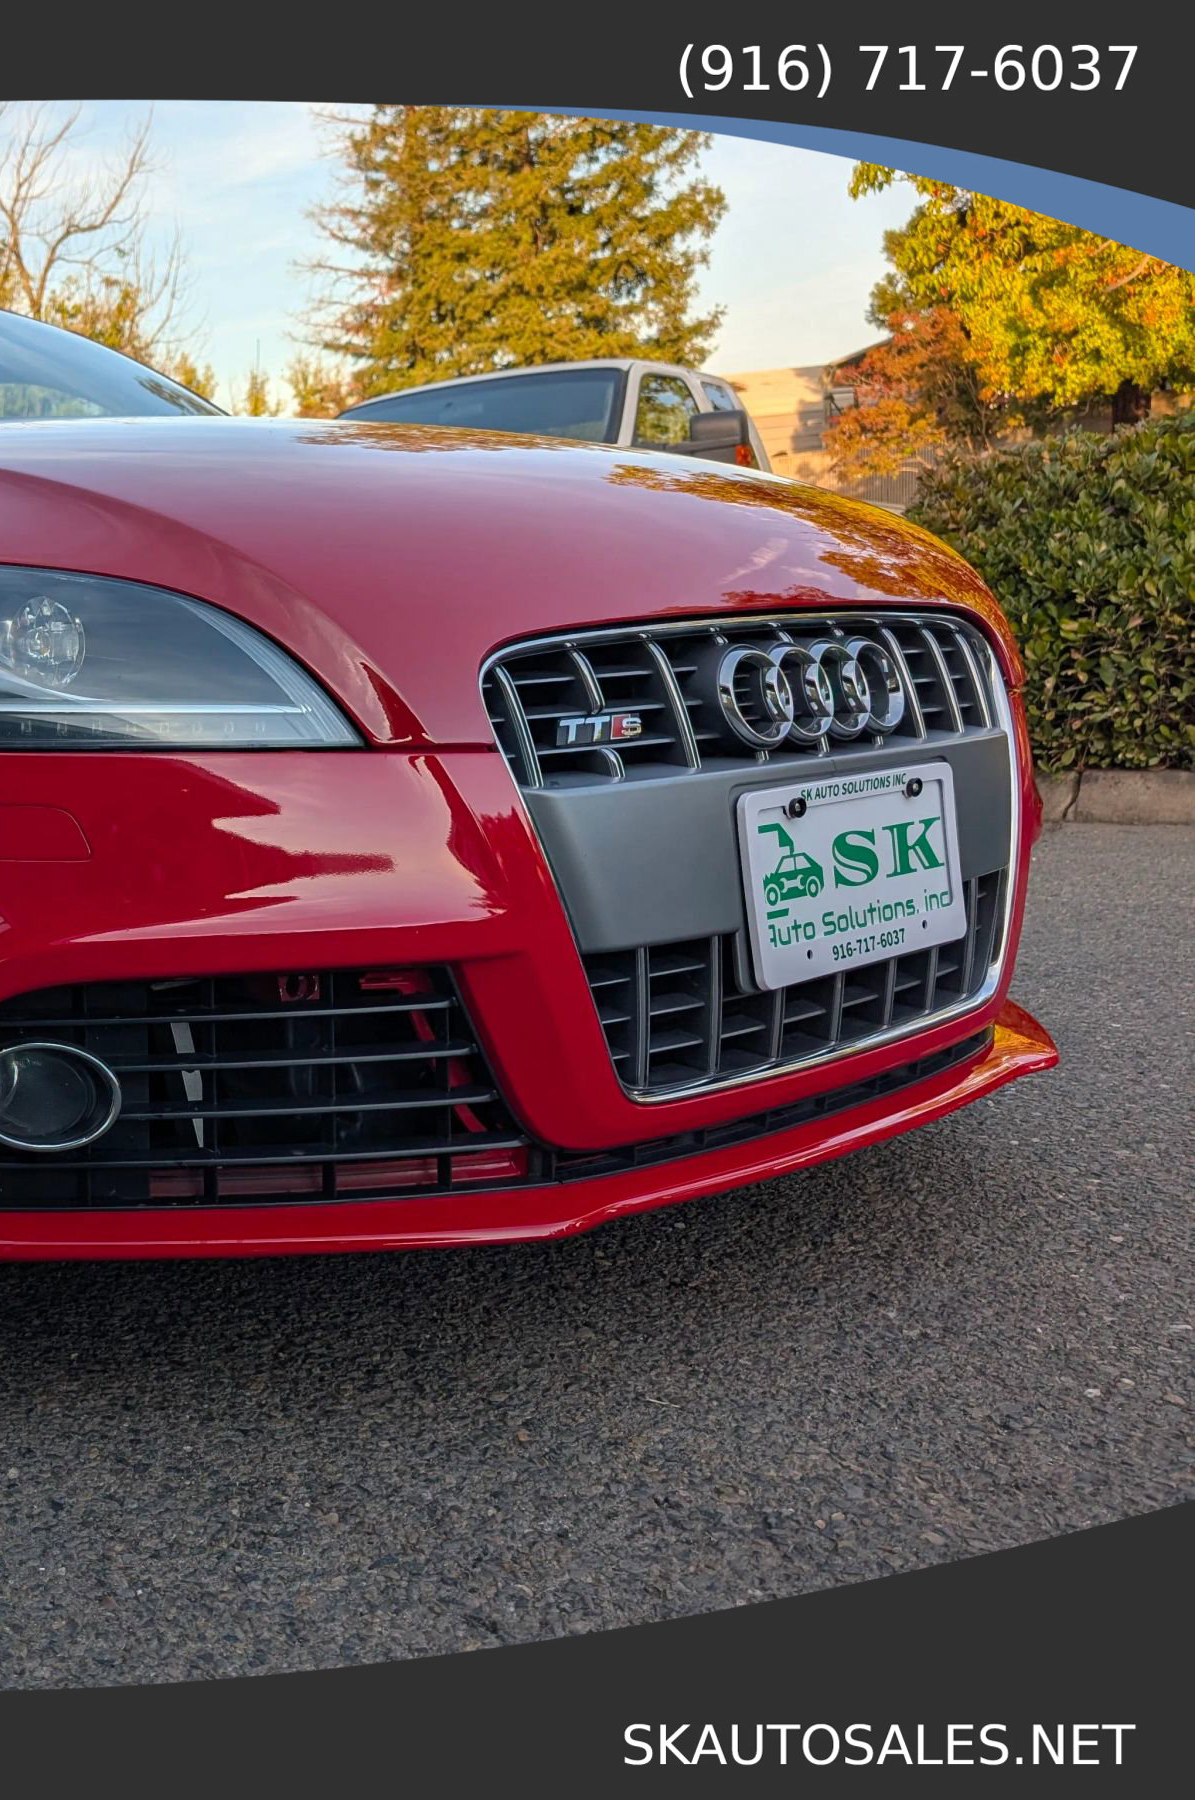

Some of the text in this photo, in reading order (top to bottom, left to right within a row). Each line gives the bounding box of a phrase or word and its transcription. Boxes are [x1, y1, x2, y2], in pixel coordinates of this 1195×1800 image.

[559, 715, 642, 744] TTS
[800, 772, 907, 802] SK AUTO SOLUTIONS INC
[832, 815, 945, 889] SK
[821, 897, 921, 937] Solutions,
[923, 888, 953, 913] inc
[831, 927, 906, 961] 916-717-6037
